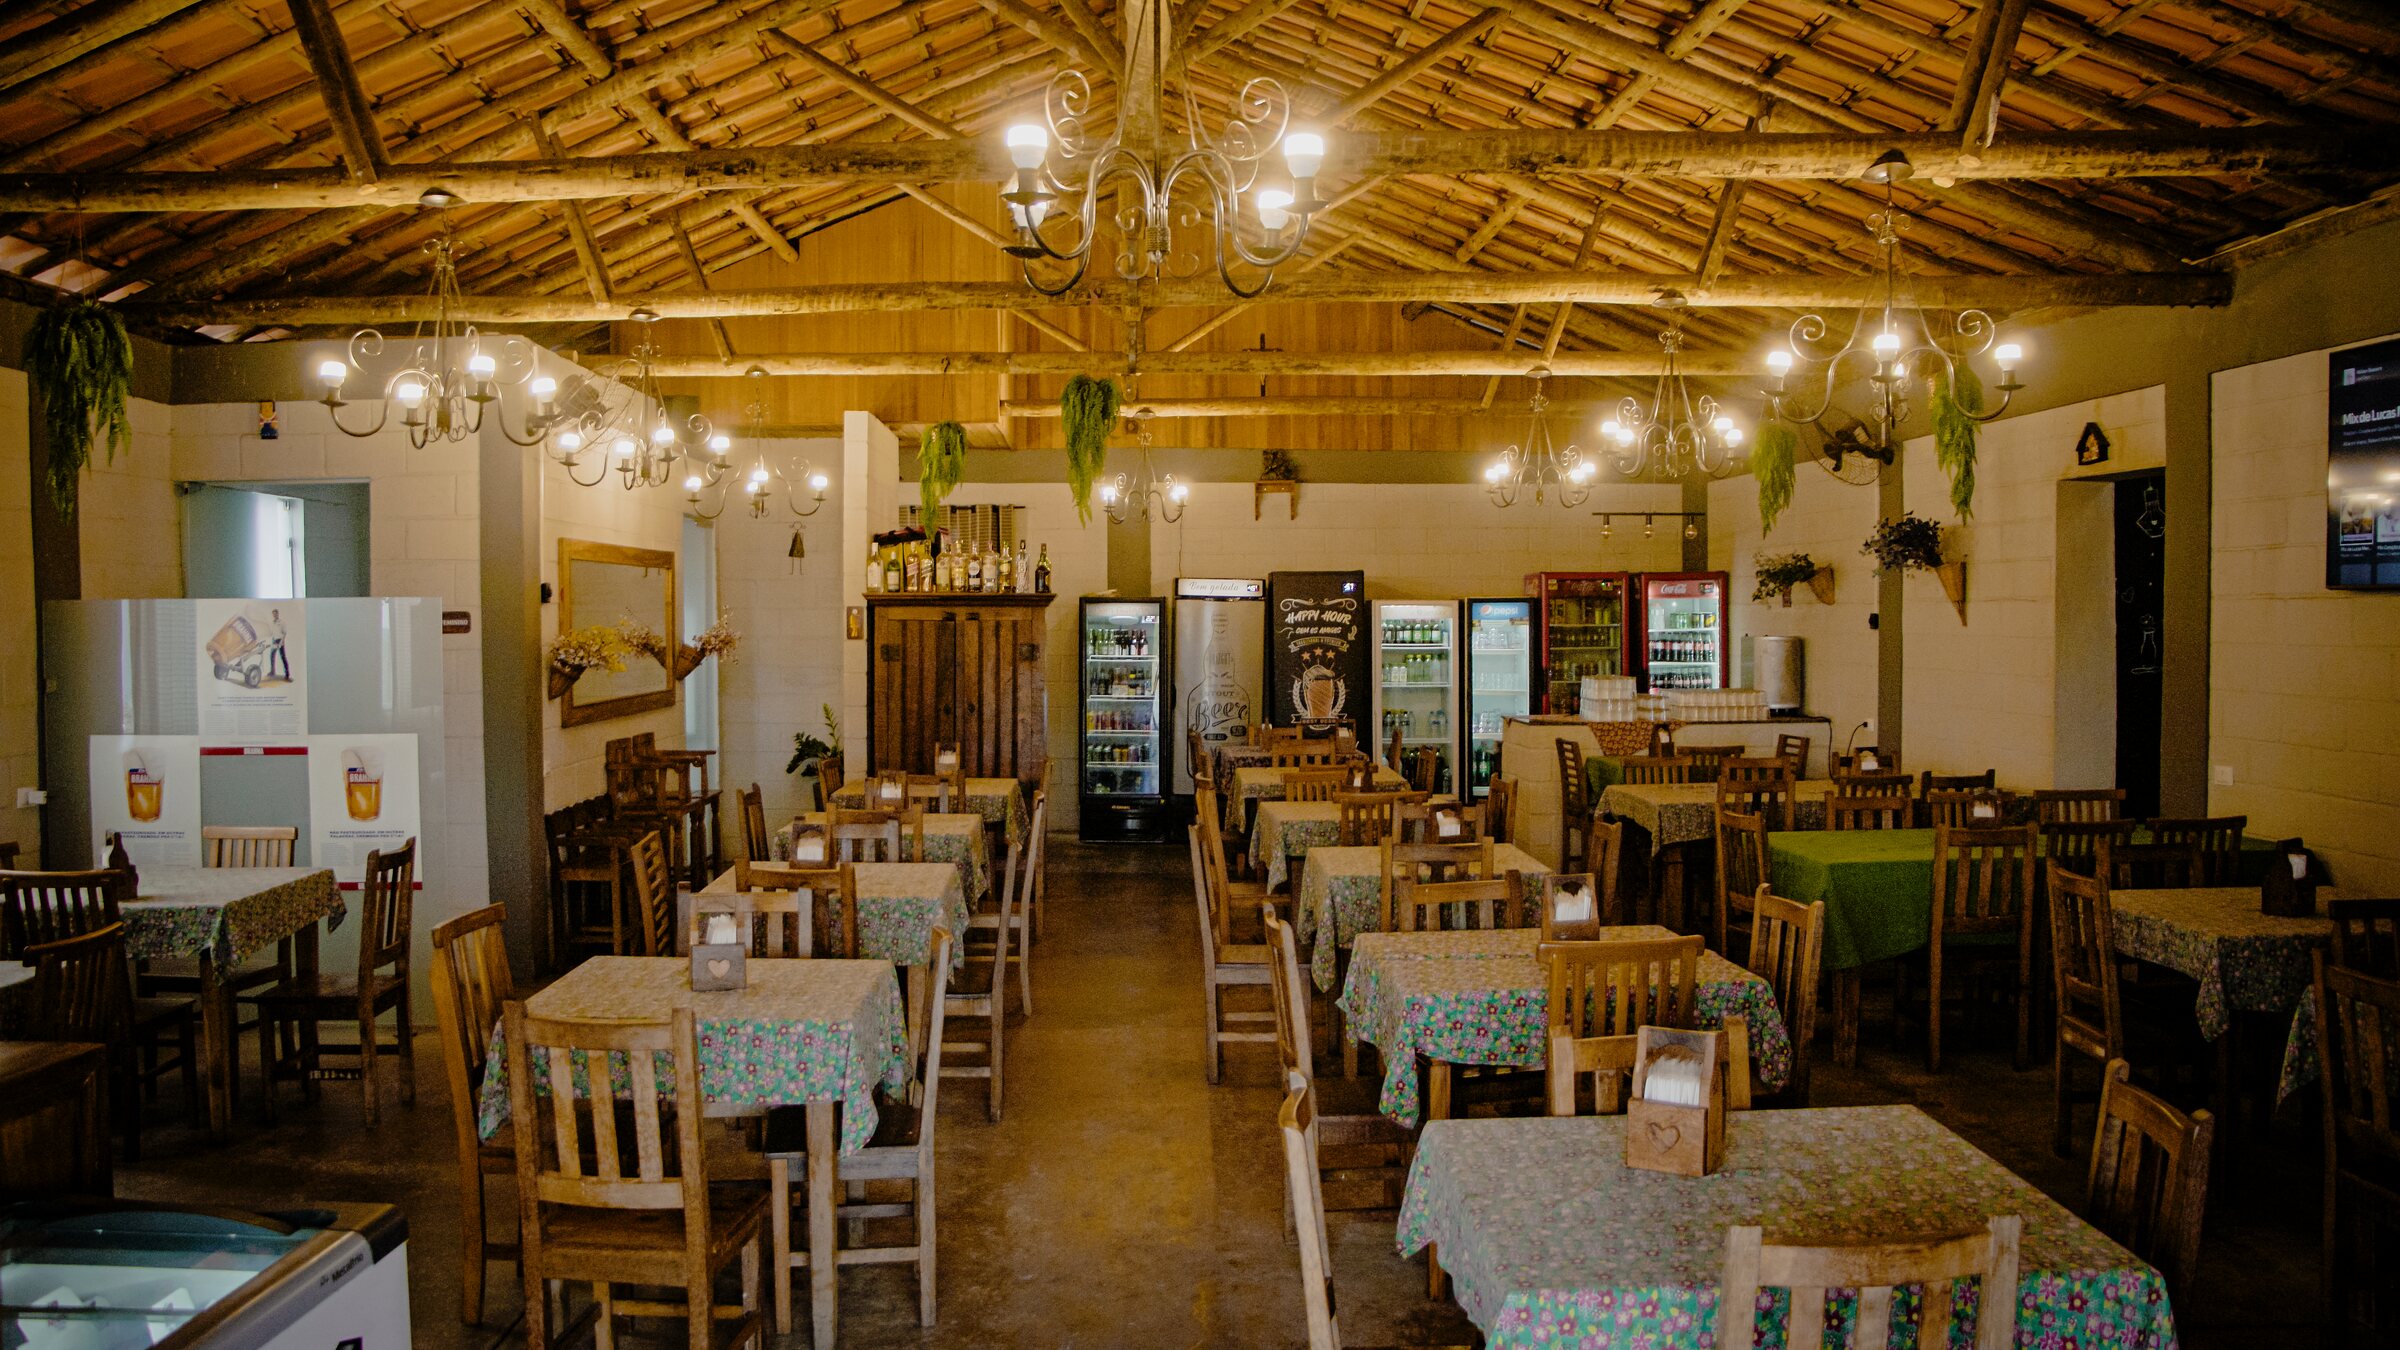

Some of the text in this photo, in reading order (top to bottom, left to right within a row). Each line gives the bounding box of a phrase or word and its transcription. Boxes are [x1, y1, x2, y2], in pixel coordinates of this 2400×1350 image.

[2343, 413, 2359, 425] Mix
[2371, 408, 2396, 421] Lucas
[1661, 583, 1687, 594] Coca-Cola
[1285, 609, 1352, 625] HAPPY HOUR
[1493, 606, 1518, 616] pepsi
